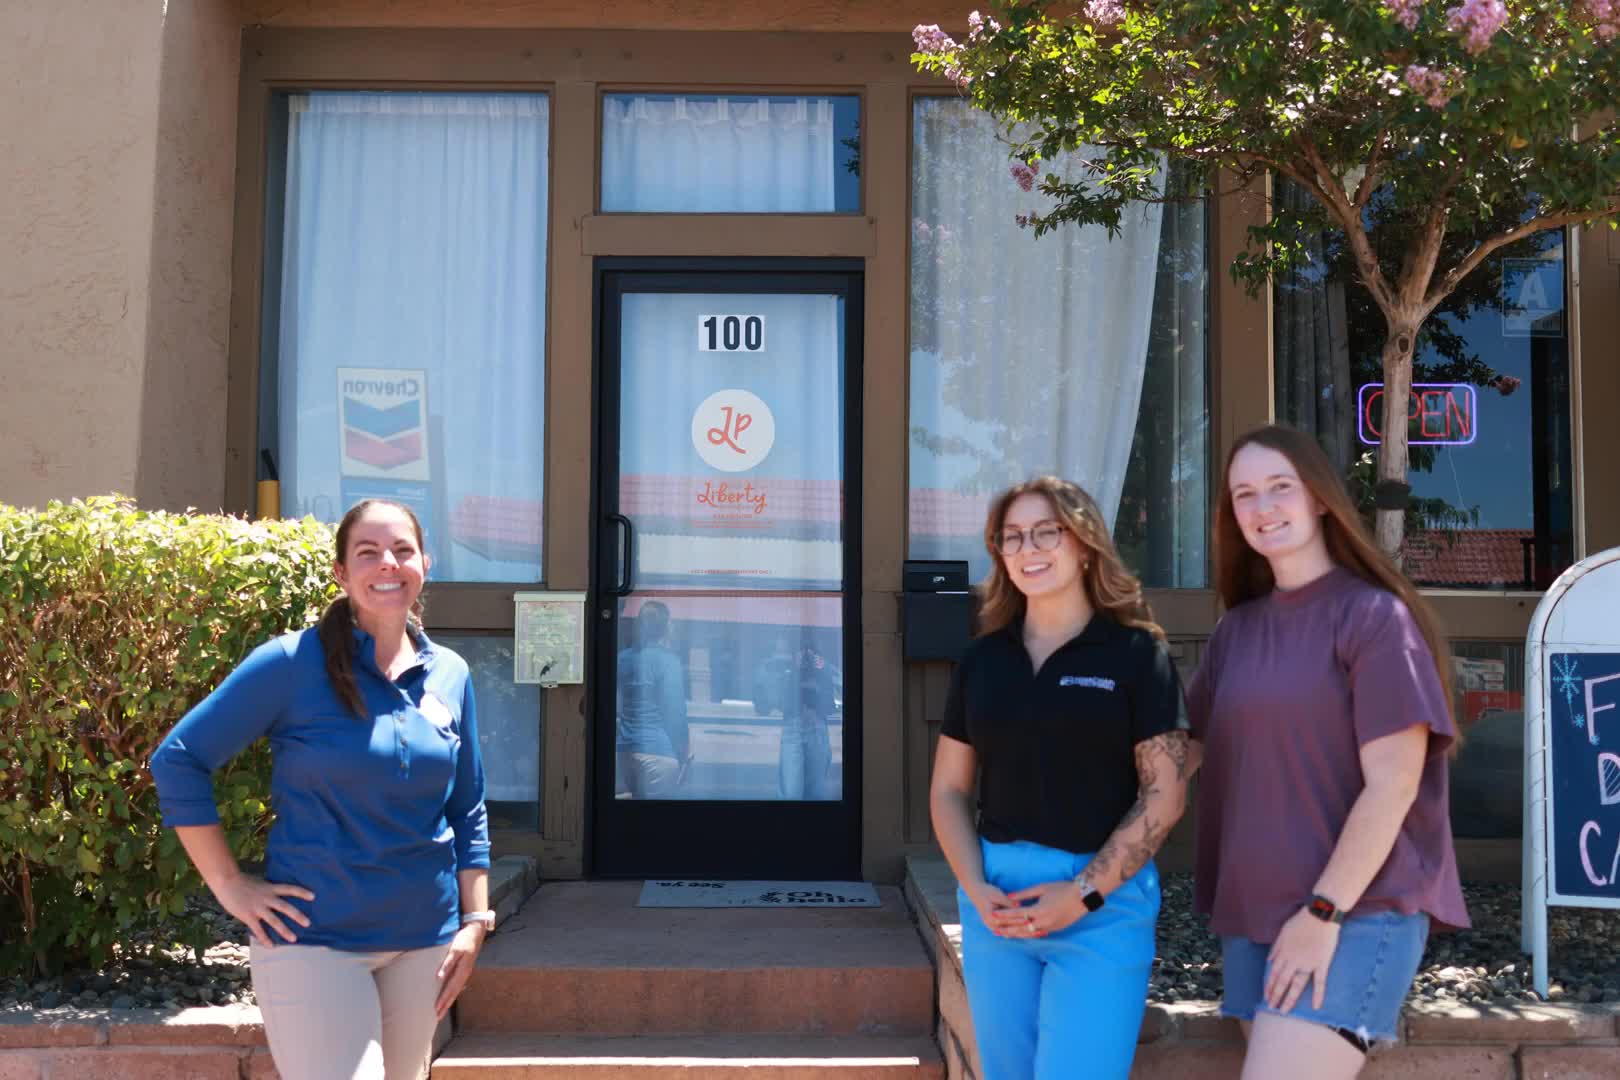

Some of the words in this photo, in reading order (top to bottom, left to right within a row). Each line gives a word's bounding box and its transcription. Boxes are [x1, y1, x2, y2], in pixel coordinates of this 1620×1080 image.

[703, 315, 763, 351] 100
[1365, 390, 1470, 437] OEN
[696, 480, 768, 514] Liberty
